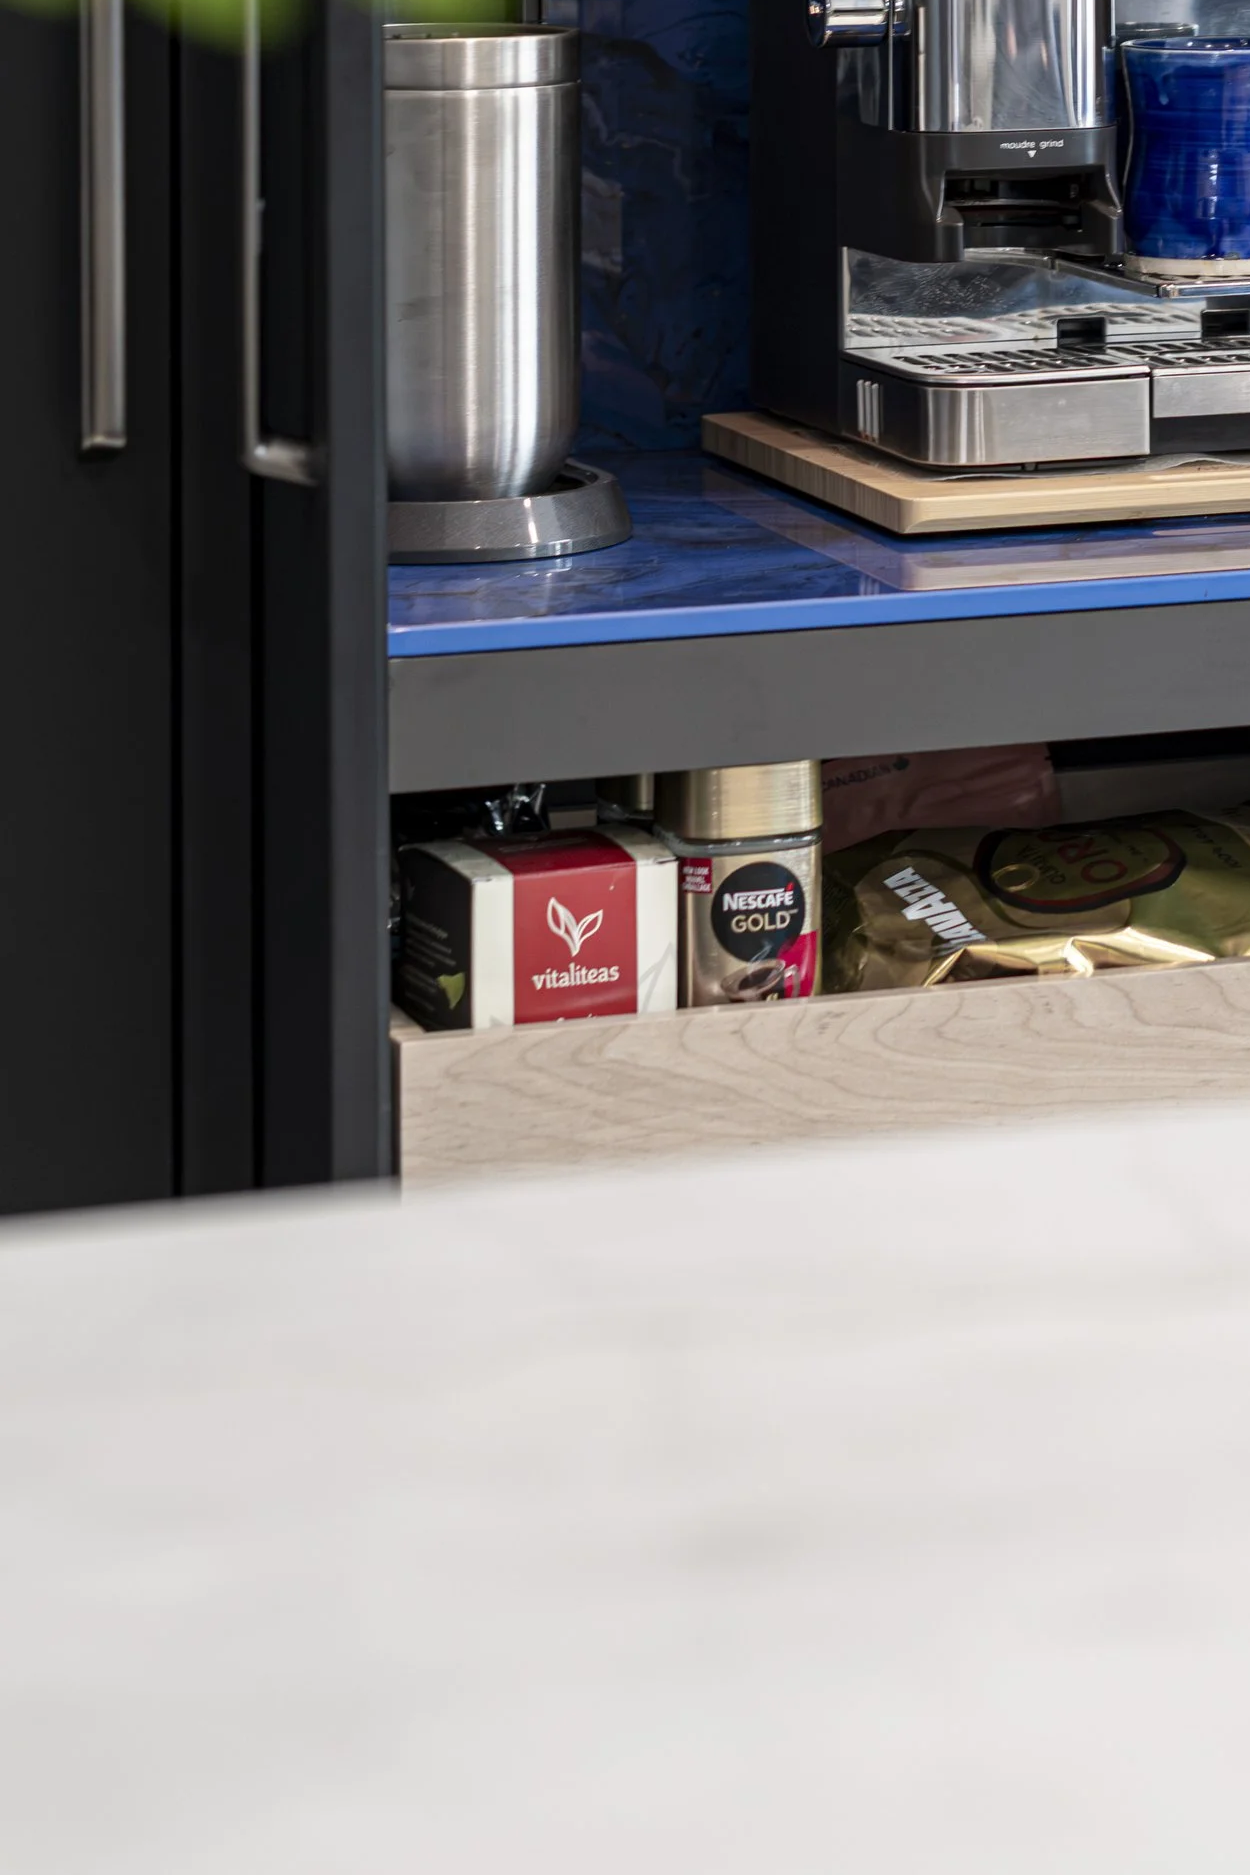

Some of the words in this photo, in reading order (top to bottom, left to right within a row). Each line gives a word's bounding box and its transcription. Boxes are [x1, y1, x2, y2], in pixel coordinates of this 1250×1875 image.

[1000, 140, 1036, 150] moudre
[1039, 139, 1064, 150] grind
[723, 882, 795, 912] NESCAFÉ
[731, 911, 792, 933] GOLD
[531, 962, 620, 991] vitaliteas
